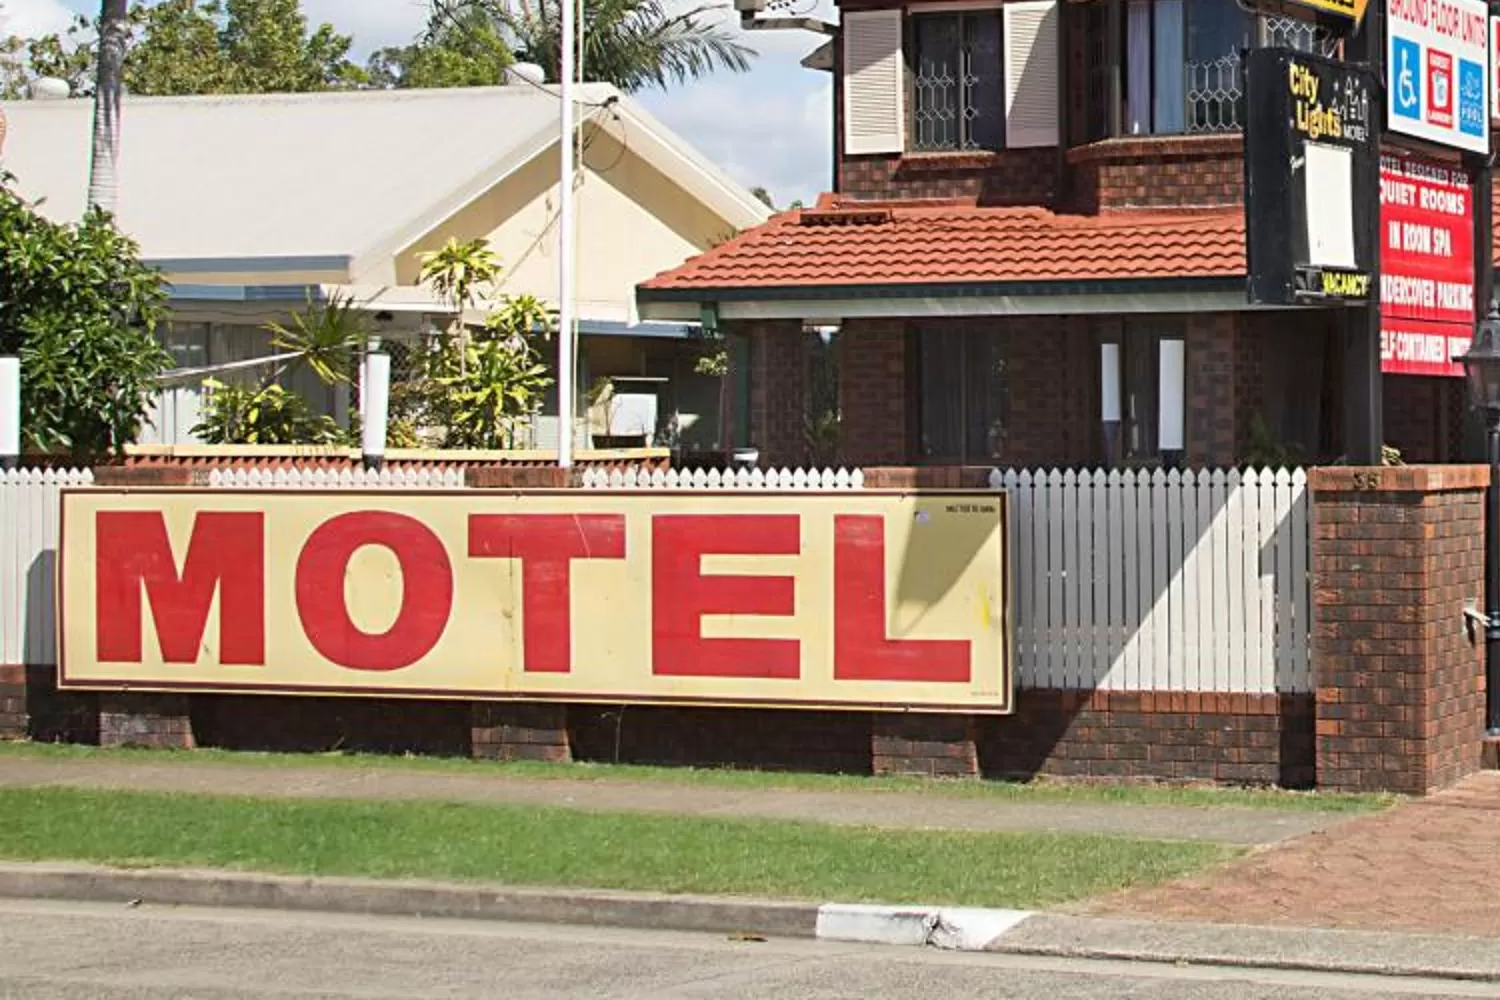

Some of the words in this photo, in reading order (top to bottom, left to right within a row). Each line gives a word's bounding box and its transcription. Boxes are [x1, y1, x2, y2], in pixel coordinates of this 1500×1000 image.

[1461, 9, 1485, 49] UNITS
[1289, 62, 1319, 104] City
[1297, 100, 1341, 140] Lights
[1380, 155, 1402, 176] OTEL
[1419, 186, 1465, 216] ROOMS
[1388, 220, 1401, 249] IN
[1403, 222, 1431, 254] ROOM
[1433, 226, 1452, 257] SPA
[1321, 271, 1372, 297] VACANCY
[1380, 274, 1435, 308] NDERCOVER
[1437, 281, 1473, 311] PARKING
[95, 509, 972, 683] MOTEL
